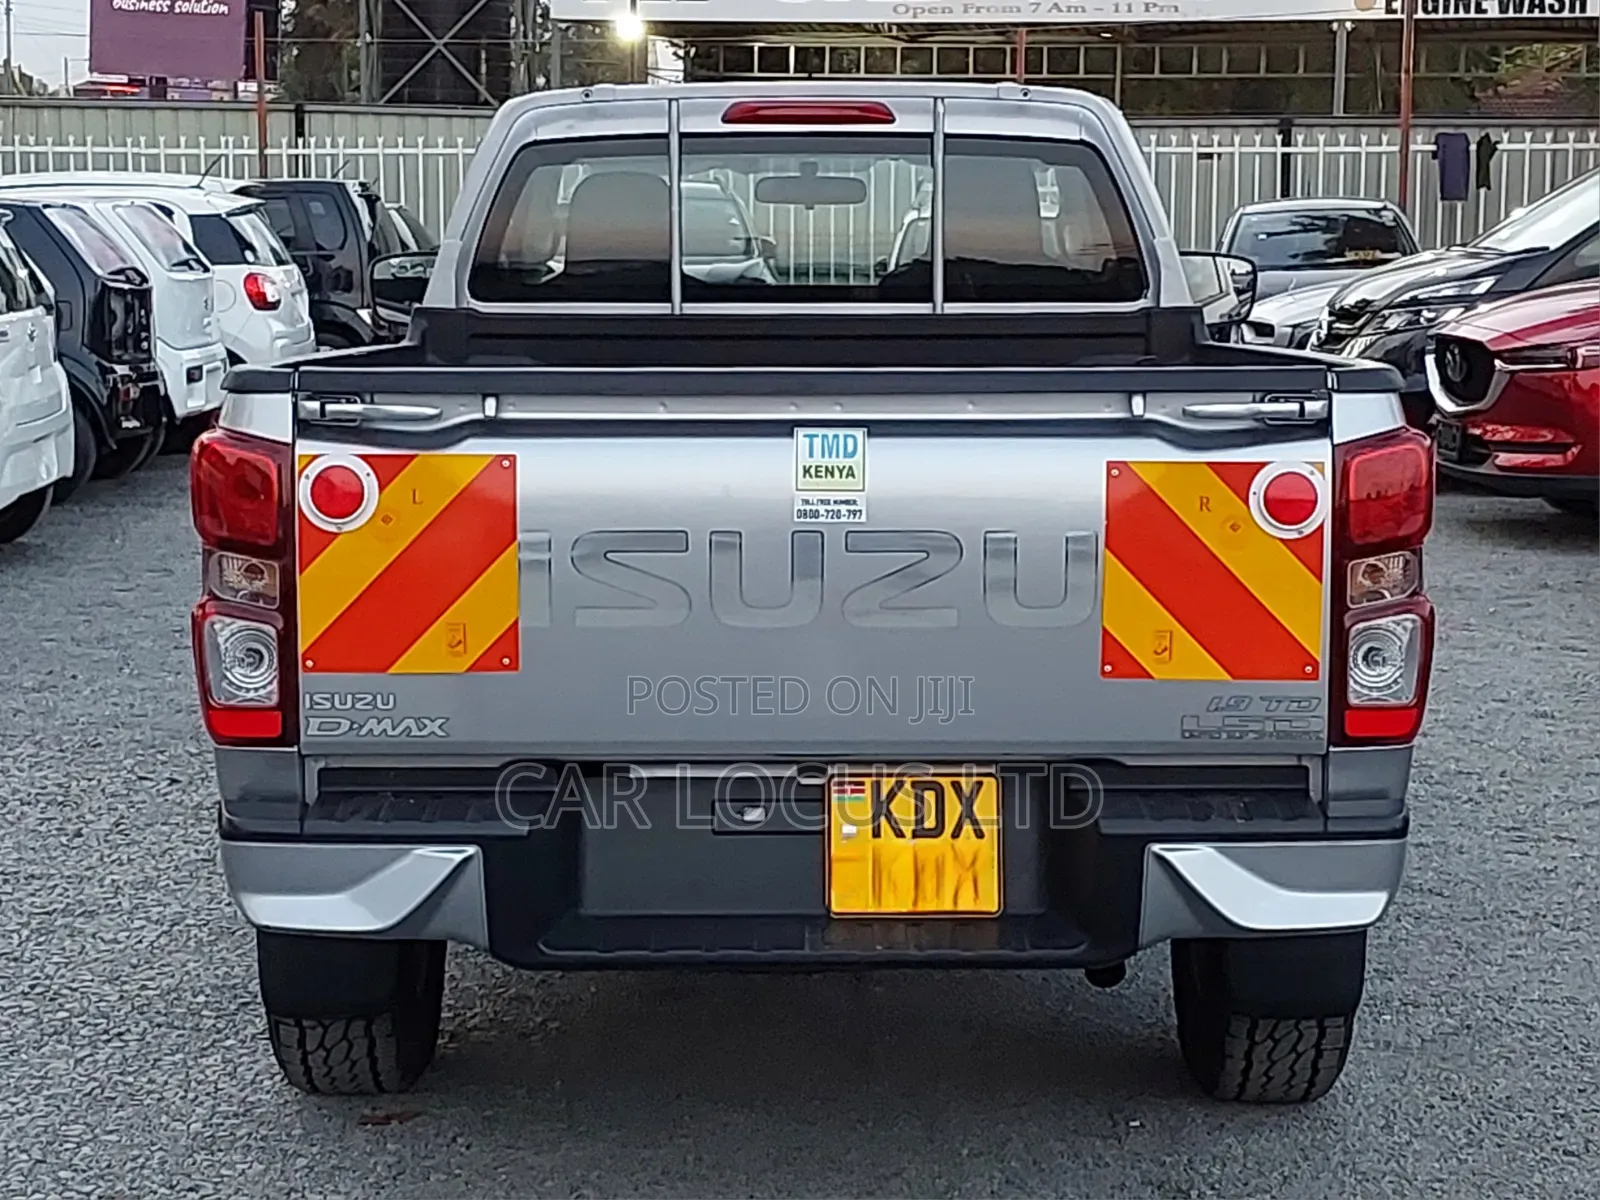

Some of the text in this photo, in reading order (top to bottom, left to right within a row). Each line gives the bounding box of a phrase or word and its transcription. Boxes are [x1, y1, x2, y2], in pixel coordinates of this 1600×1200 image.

[113, 0, 229, 15] business solution
[892, 3, 954, 18] Open
[962, 3, 1021, 14] From
[1029, 2, 1041, 13] 7
[1047, 2, 1087, 13] Am
[1112, 2, 1133, 13] 11
[1143, 2, 1180, 13] Pm
[1498, 0, 1588, 15] WASH
[802, 433, 859, 459] TMD
[802, 464, 857, 480] KENYA
[411, 488, 423, 505] L
[1199, 495, 1212, 512] R
[796, 508, 863, 520] 0800-720-797
[518, 529, 1099, 629] ISUZU
[304, 692, 396, 711] ISUZU
[1206, 694, 1323, 712] 1.9 TD
[1181, 714, 1325, 732] LSD
[871, 780, 986, 839] KDX
